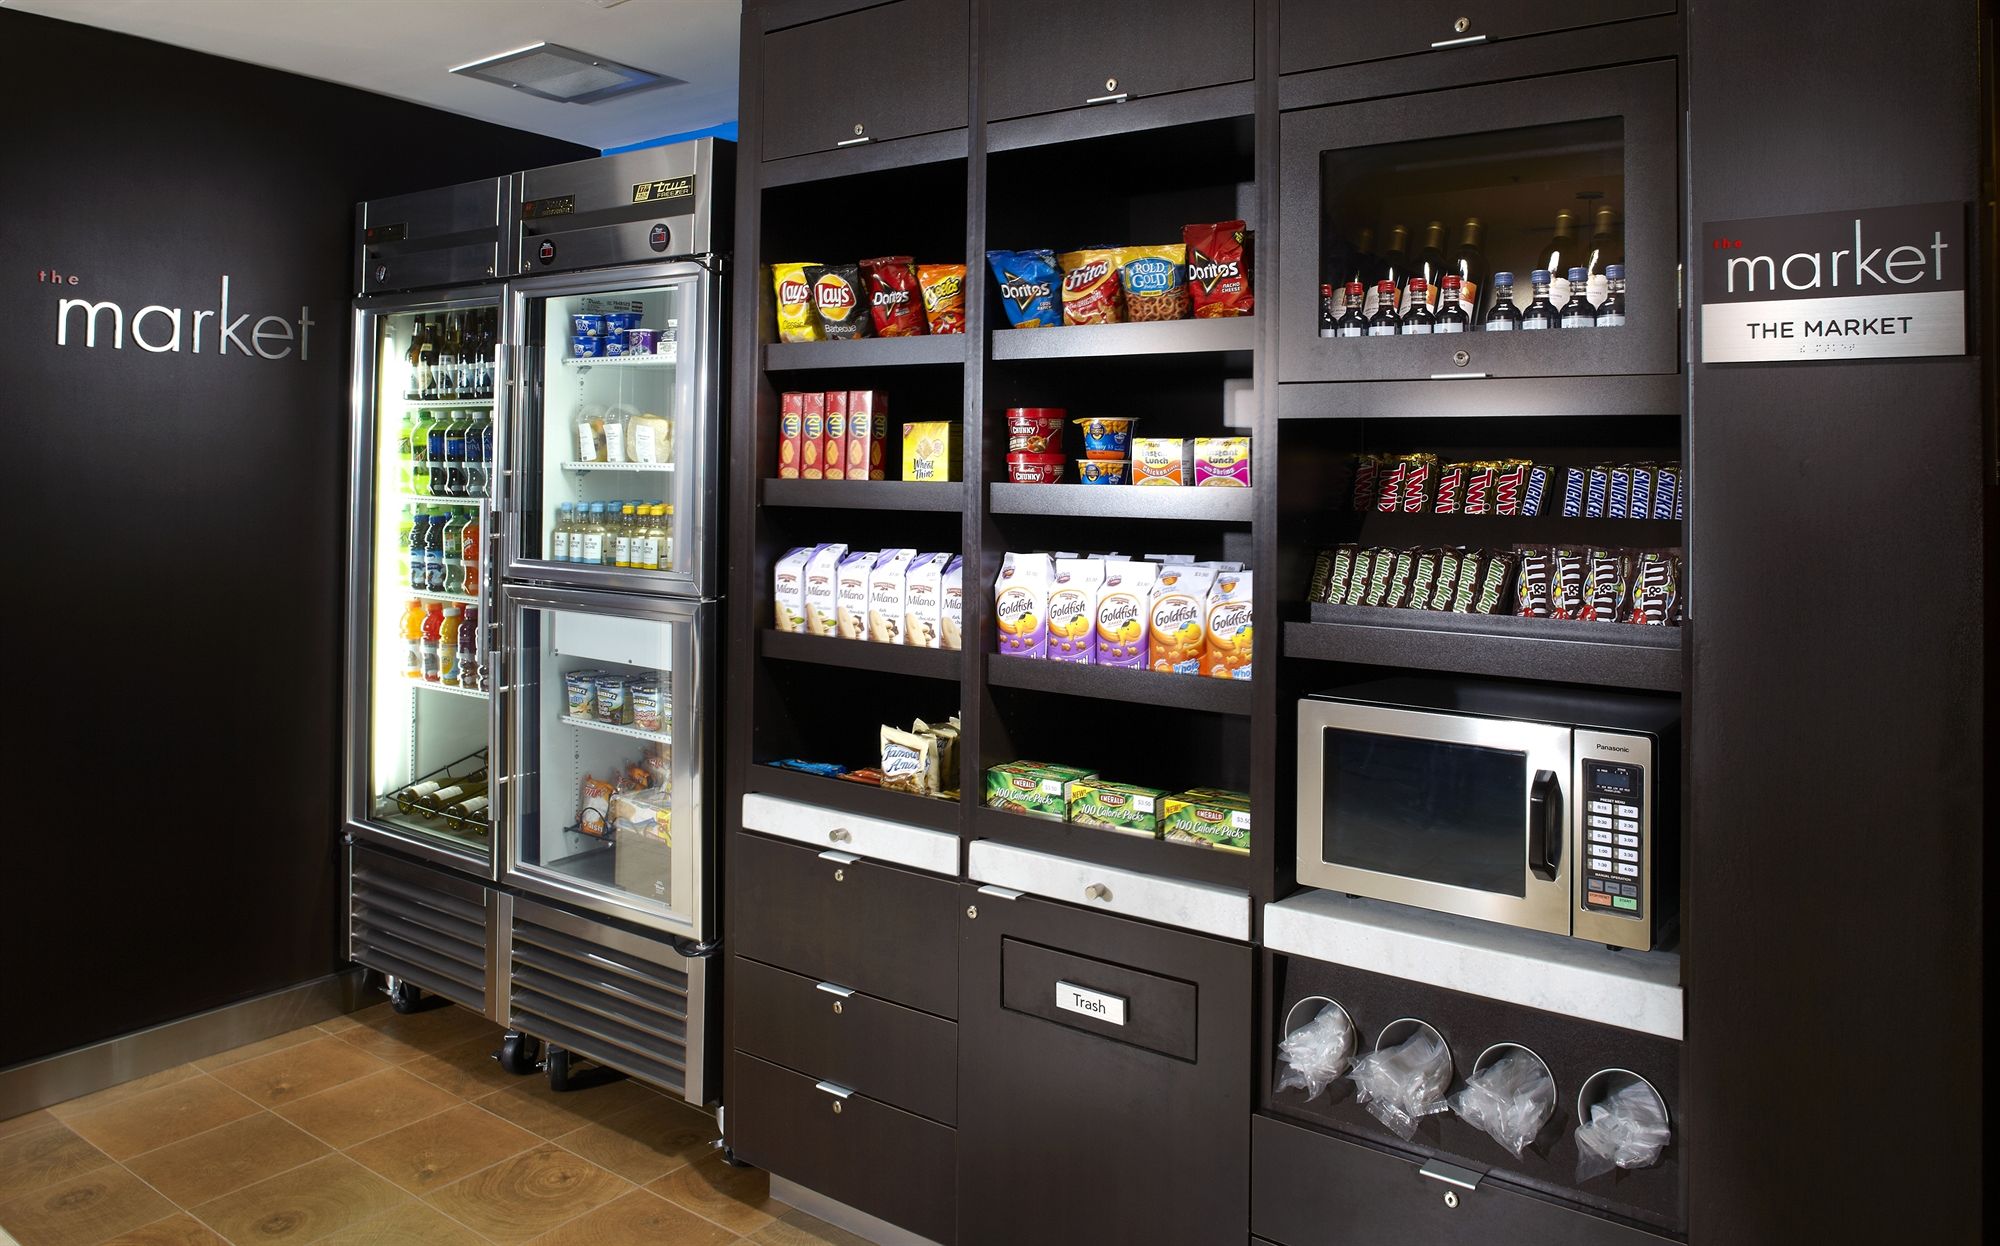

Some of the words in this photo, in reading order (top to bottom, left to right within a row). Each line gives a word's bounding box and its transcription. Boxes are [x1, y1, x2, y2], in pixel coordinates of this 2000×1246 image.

[1713, 238, 1743, 250] the
[1727, 219, 1948, 293] market
[1135, 262, 1165, 274] ROLD
[1189, 261, 1239, 281] Doritos
[38, 270, 79, 286] the
[1065, 261, 1109, 291] Fritos
[1131, 272, 1167, 288] GOLD
[782, 282, 810, 304] Lay's
[818, 284, 850, 308] Lay's
[872, 291, 909, 306] Doritos
[1001, 283, 1050, 299] Doritos
[57, 275, 315, 361] market
[824, 324, 857, 333] Barbecue
[1747, 322, 1795, 339] THE
[1804, 316, 1912, 337] MARKET
[1012, 426, 1036, 435] CHUNKY
[1145, 457, 1169, 465] Lunch
[1208, 456, 1235, 464] Lunch
[1142, 465, 1167, 475] Chicken
[1015, 474, 1041, 482] CHUNKY
[807, 586, 831, 597] Milano
[838, 589, 864, 600] Milano
[869, 592, 899, 604] Milano
[906, 595, 936, 607] Milano
[998, 599, 1033, 617] Goldfish
[1050, 601, 1086, 619] Goldfish
[1100, 605, 1138, 624] Goldfish
[1155, 607, 1198, 627] Goldfish
[1173, 662, 1199, 674] Whole
[1596, 743, 1630, 753] Panasonic
[1013, 780, 1035, 789] EMERALD
[996, 787, 1012, 797] 100
[1011, 791, 1033, 801] Calorie
[1032, 795, 1053, 805] Packs
[1101, 795, 1124, 804] EMERALD
[1081, 804, 1096, 814] 100
[1096, 808, 1124, 819] Calorie
[1122, 812, 1145, 822] Packs
[1197, 810, 1223, 821] EMERALD
[1176, 819, 1192, 829] 100
[1193, 823, 1220, 835] Calorie
[1219, 827, 1245, 838] Packs
[1073, 993, 1106, 1014] Trash
